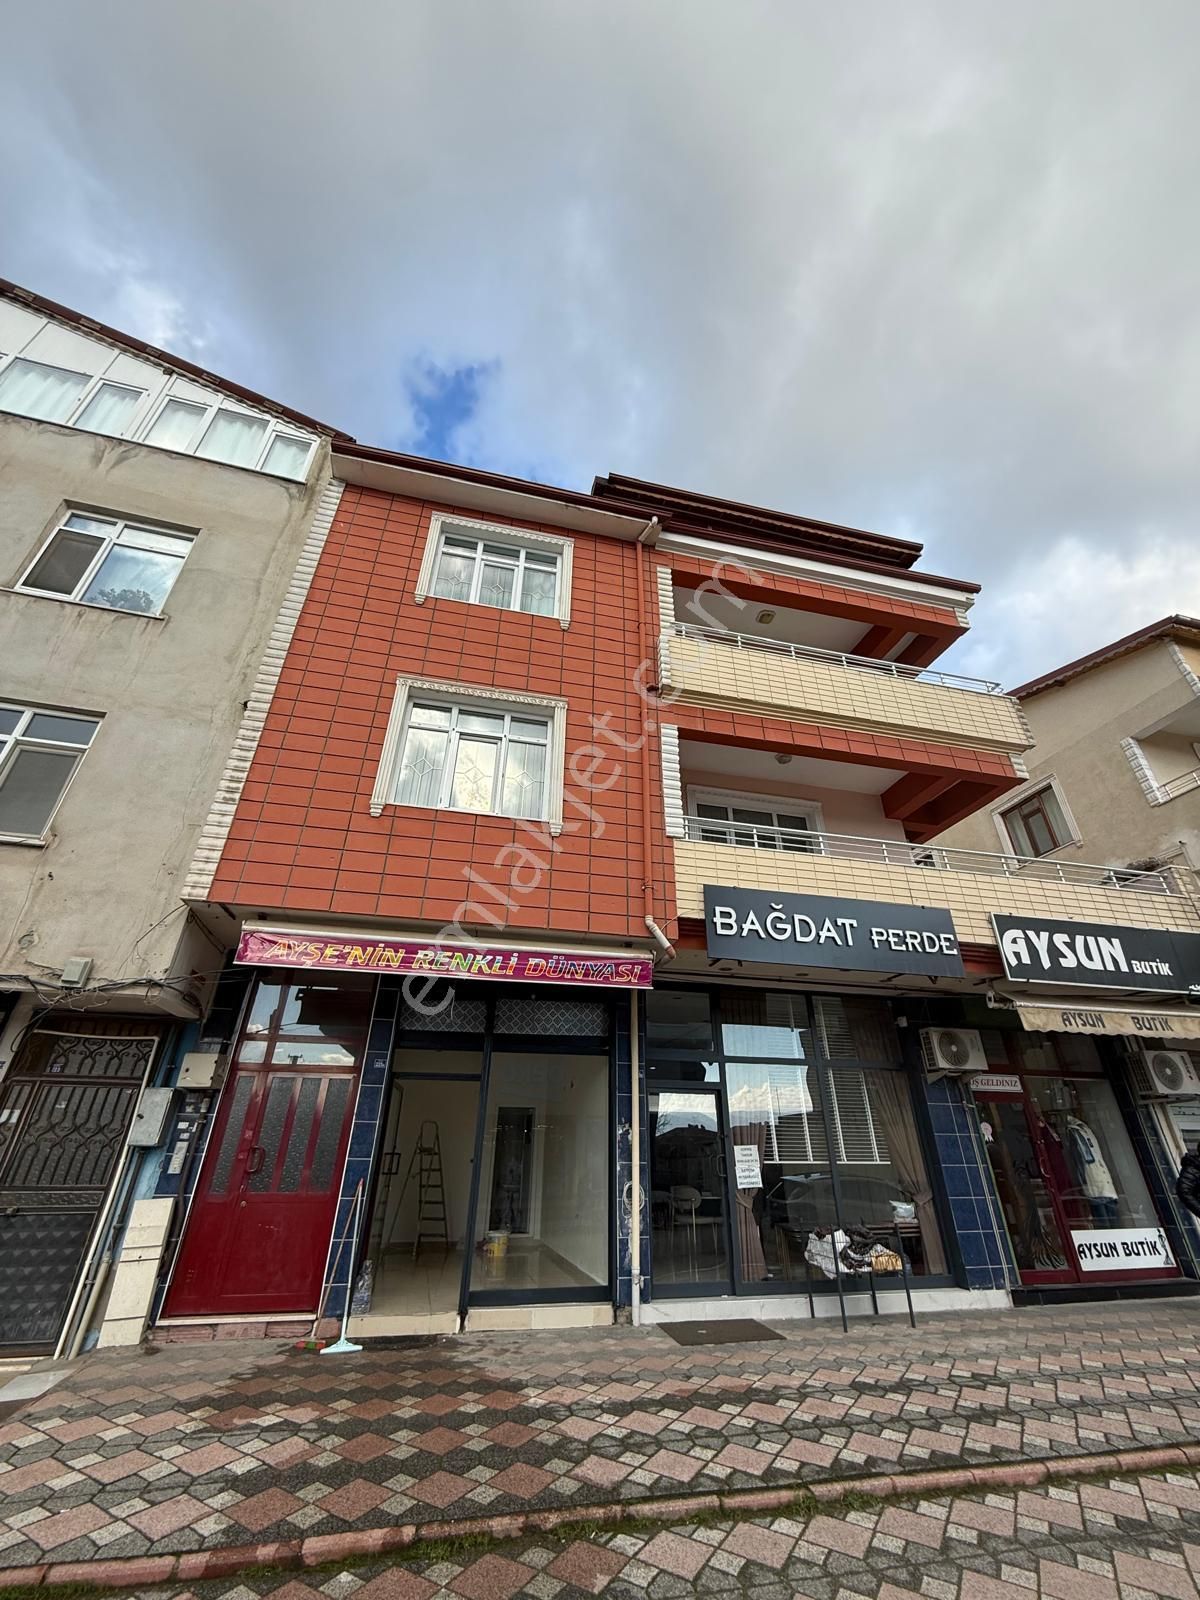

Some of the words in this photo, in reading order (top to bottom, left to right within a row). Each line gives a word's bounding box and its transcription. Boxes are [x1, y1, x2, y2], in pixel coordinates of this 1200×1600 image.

[713, 903, 858, 946] BAĞDAT
[871, 927, 958, 955] PERDE
[262, 938, 402, 968] AYŞE'NİN
[411, 950, 519, 975] RENKLİ
[524, 955, 642, 983] DÜNYASI
[1002, 928, 1129, 973] AYSUN
[1131, 958, 1174, 977] BUTİK
[1061, 1011, 1106, 1029] AYSUN
[1131, 1015, 1174, 1032] BUTİK
[1077, 1241, 1120, 1260] AYSUN
[1120, 1237, 1162, 1257] BUTİK
